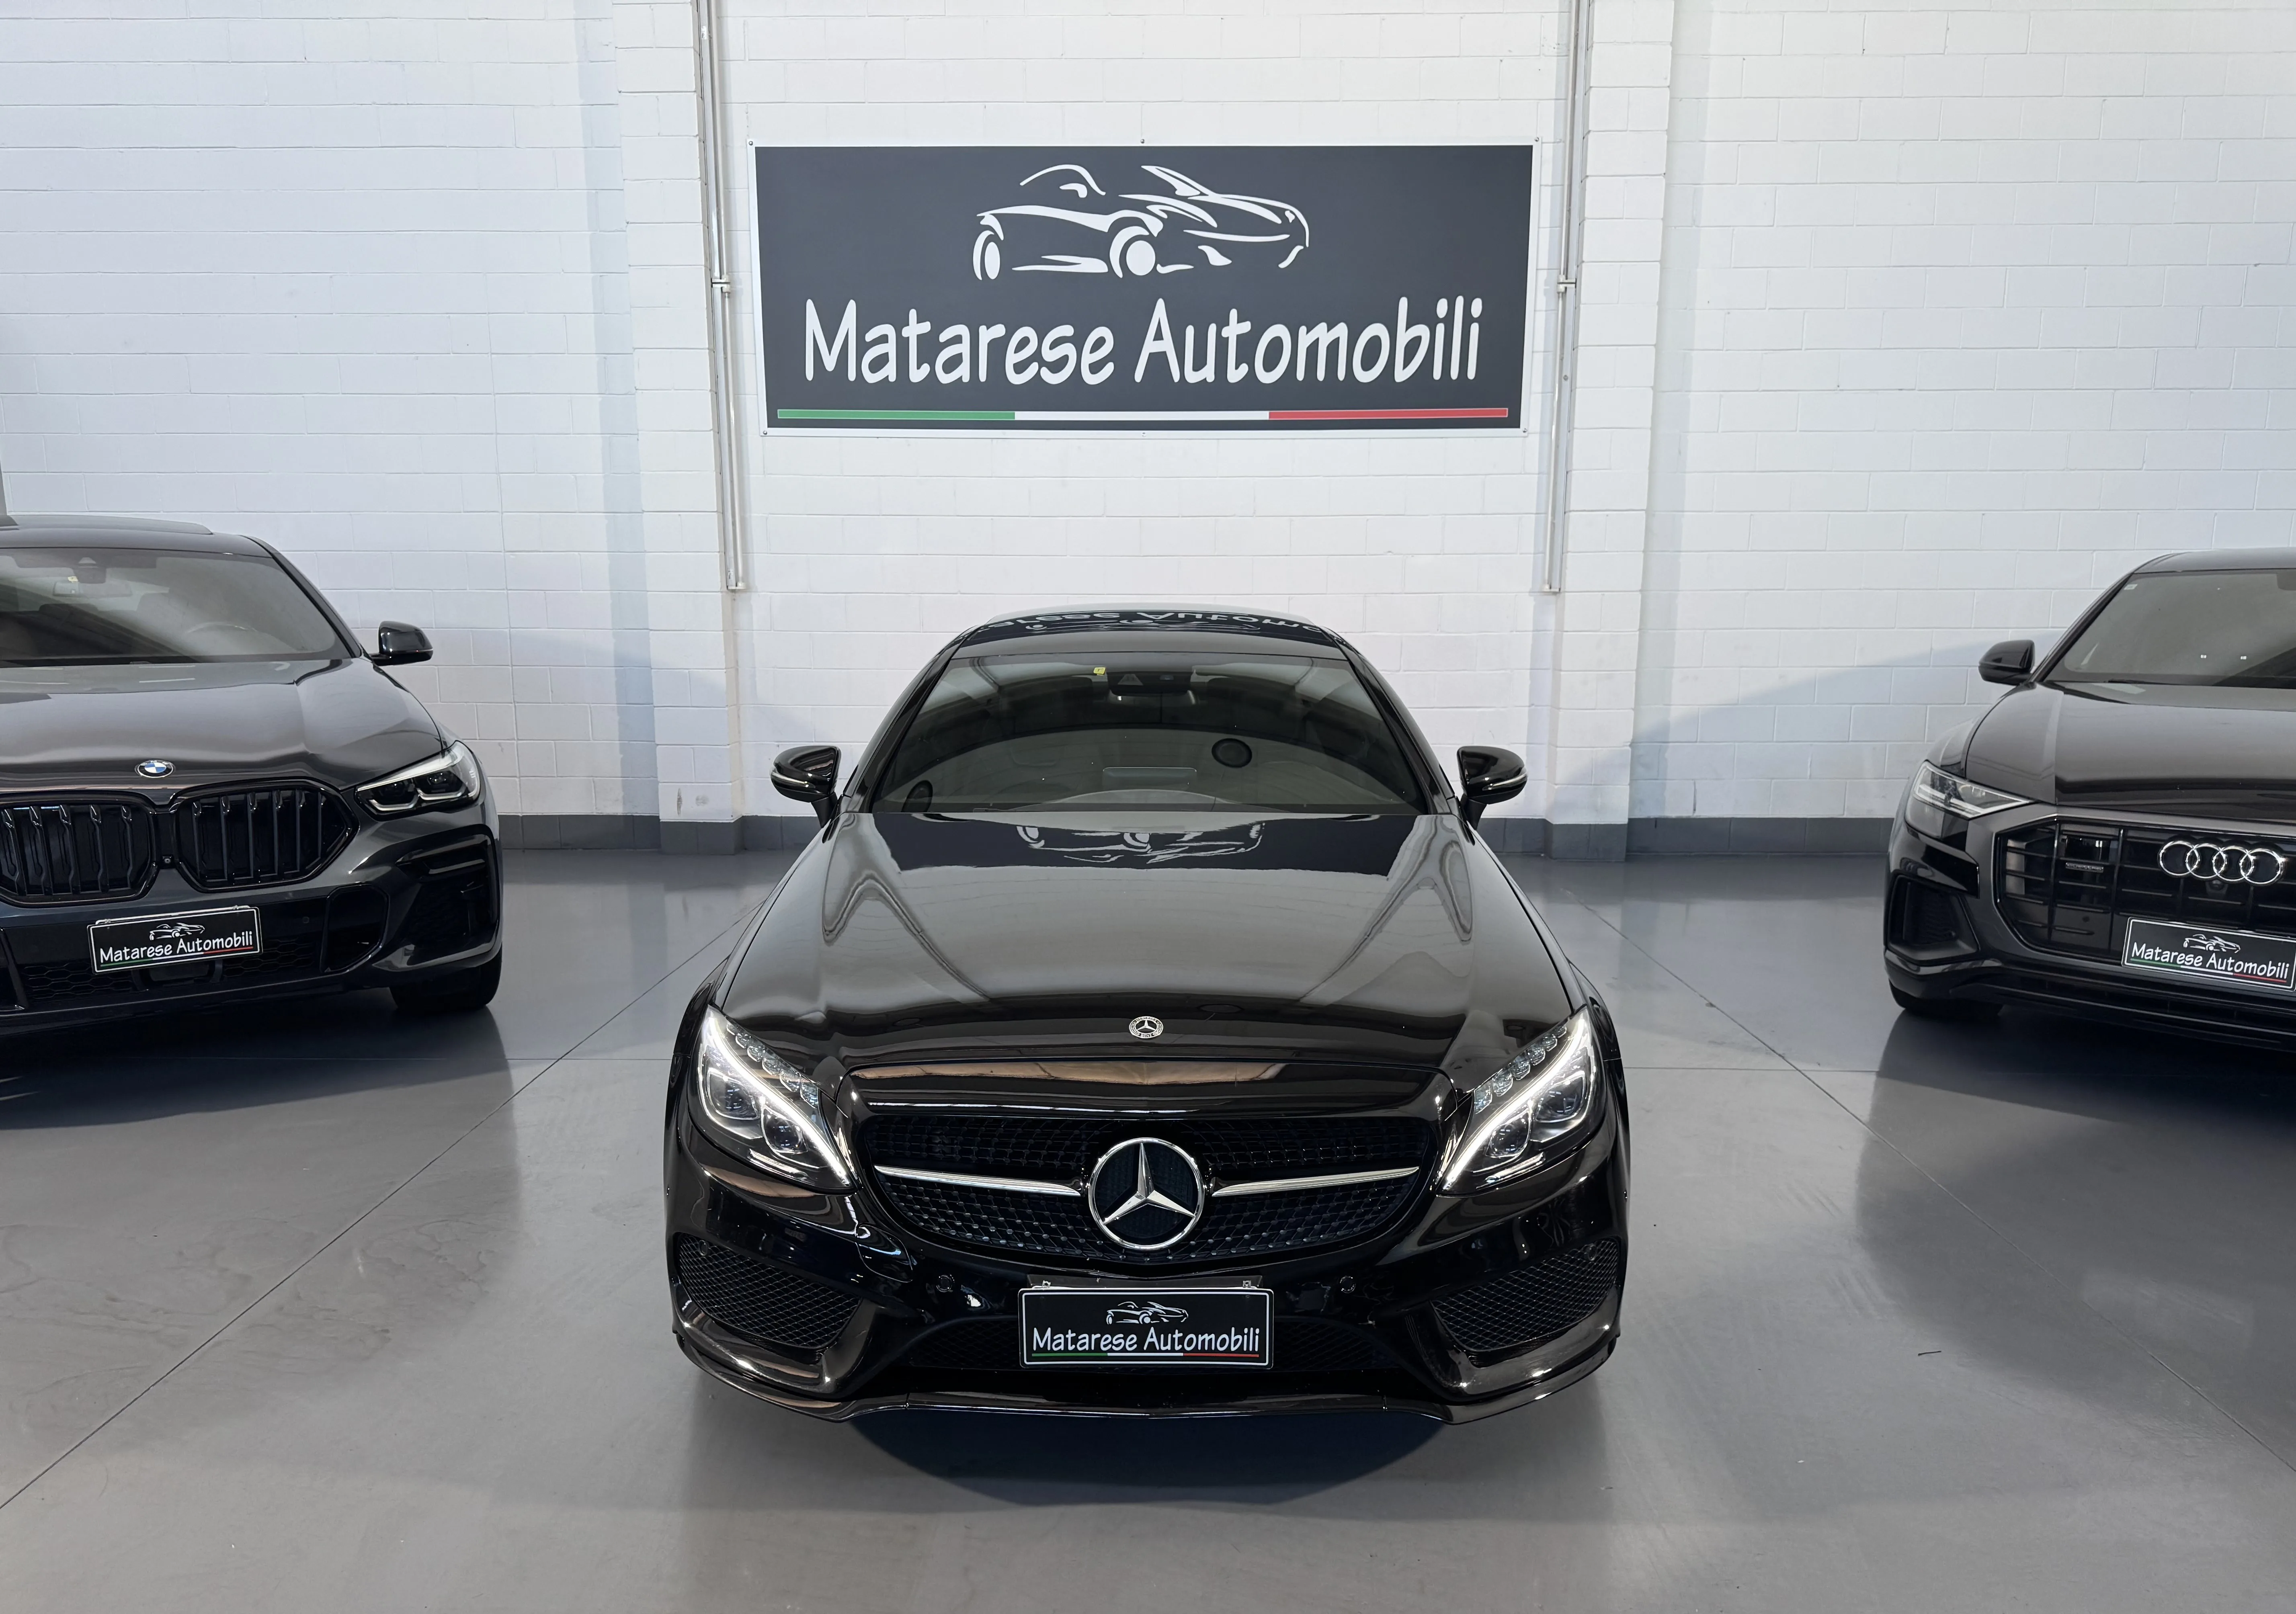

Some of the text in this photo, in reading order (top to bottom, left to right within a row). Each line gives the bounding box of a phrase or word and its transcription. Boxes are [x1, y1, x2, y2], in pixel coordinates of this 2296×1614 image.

[805, 295, 1483, 386] Matarese Automobili
[100, 930, 253, 963] Matarese Automobili
[2131, 942, 2290, 979] Matarese Automobili
[1033, 1326, 1260, 1352] Matarese Automobili
